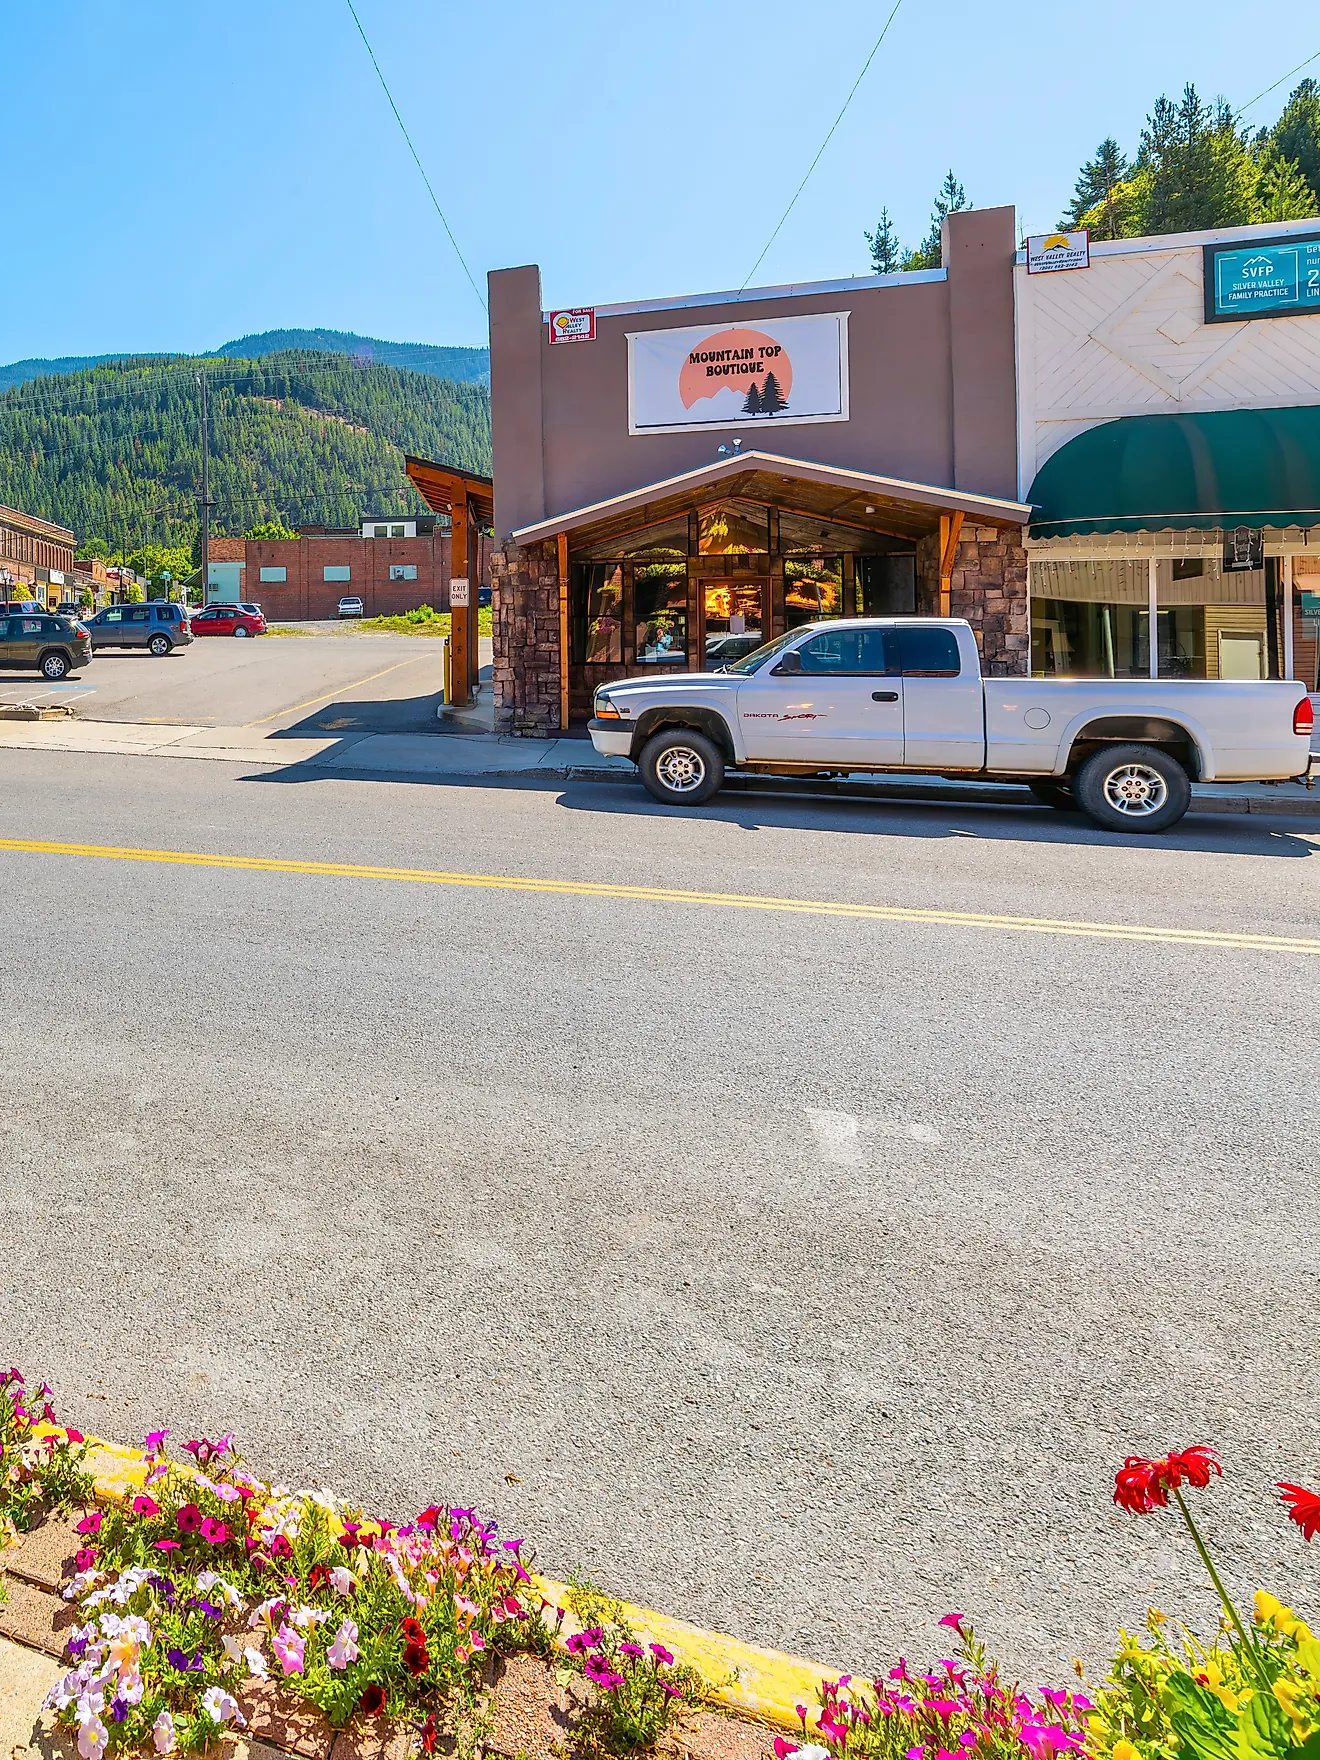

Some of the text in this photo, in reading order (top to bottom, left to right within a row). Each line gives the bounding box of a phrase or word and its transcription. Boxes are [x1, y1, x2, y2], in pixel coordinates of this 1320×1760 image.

[1242, 266, 1273, 279] SVFP
[1232, 278, 1284, 291] SILVER VALLEY
[1228, 287, 1288, 301] FAMILY PRACTICE
[689, 345, 782, 364] MOUNTAIN TOP
[706, 361, 764, 377] BOUTIQUE
